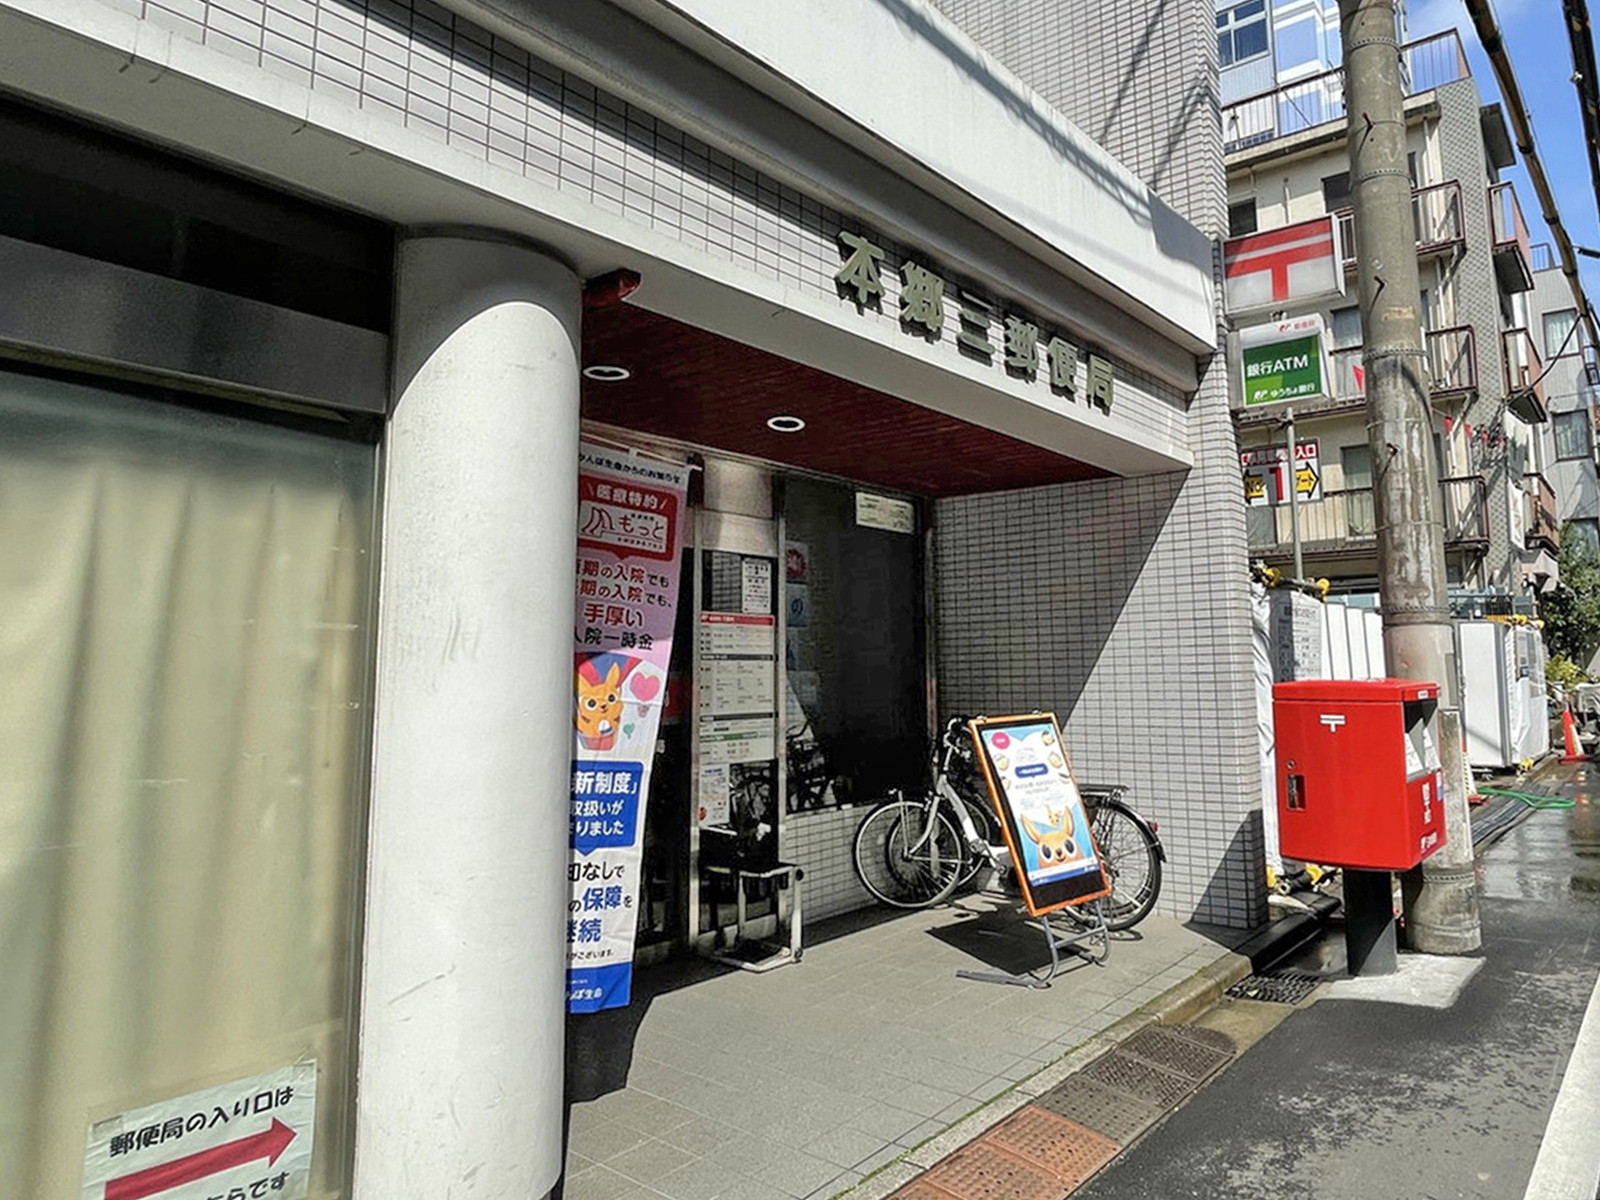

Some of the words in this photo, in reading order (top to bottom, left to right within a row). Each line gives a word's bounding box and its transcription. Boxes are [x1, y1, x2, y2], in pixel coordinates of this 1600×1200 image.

[834, 229, 1114, 408] 本郷三郵便局
[1246, 354, 1310, 378] 銀行ATM
[596, 483, 659, 510] 医療特約
[618, 515, 665, 541] もっと
[576, 558, 670, 588] 期の入院でも
[576, 578, 672, 608] 期の入院でも、
[584, 603, 643, 627] 手厚い
[571, 770, 638, 795] 新制度」
[566, 986, 603, 1002] んぽ生命
[109, 1085, 295, 1158] 郵便局の入り口は
